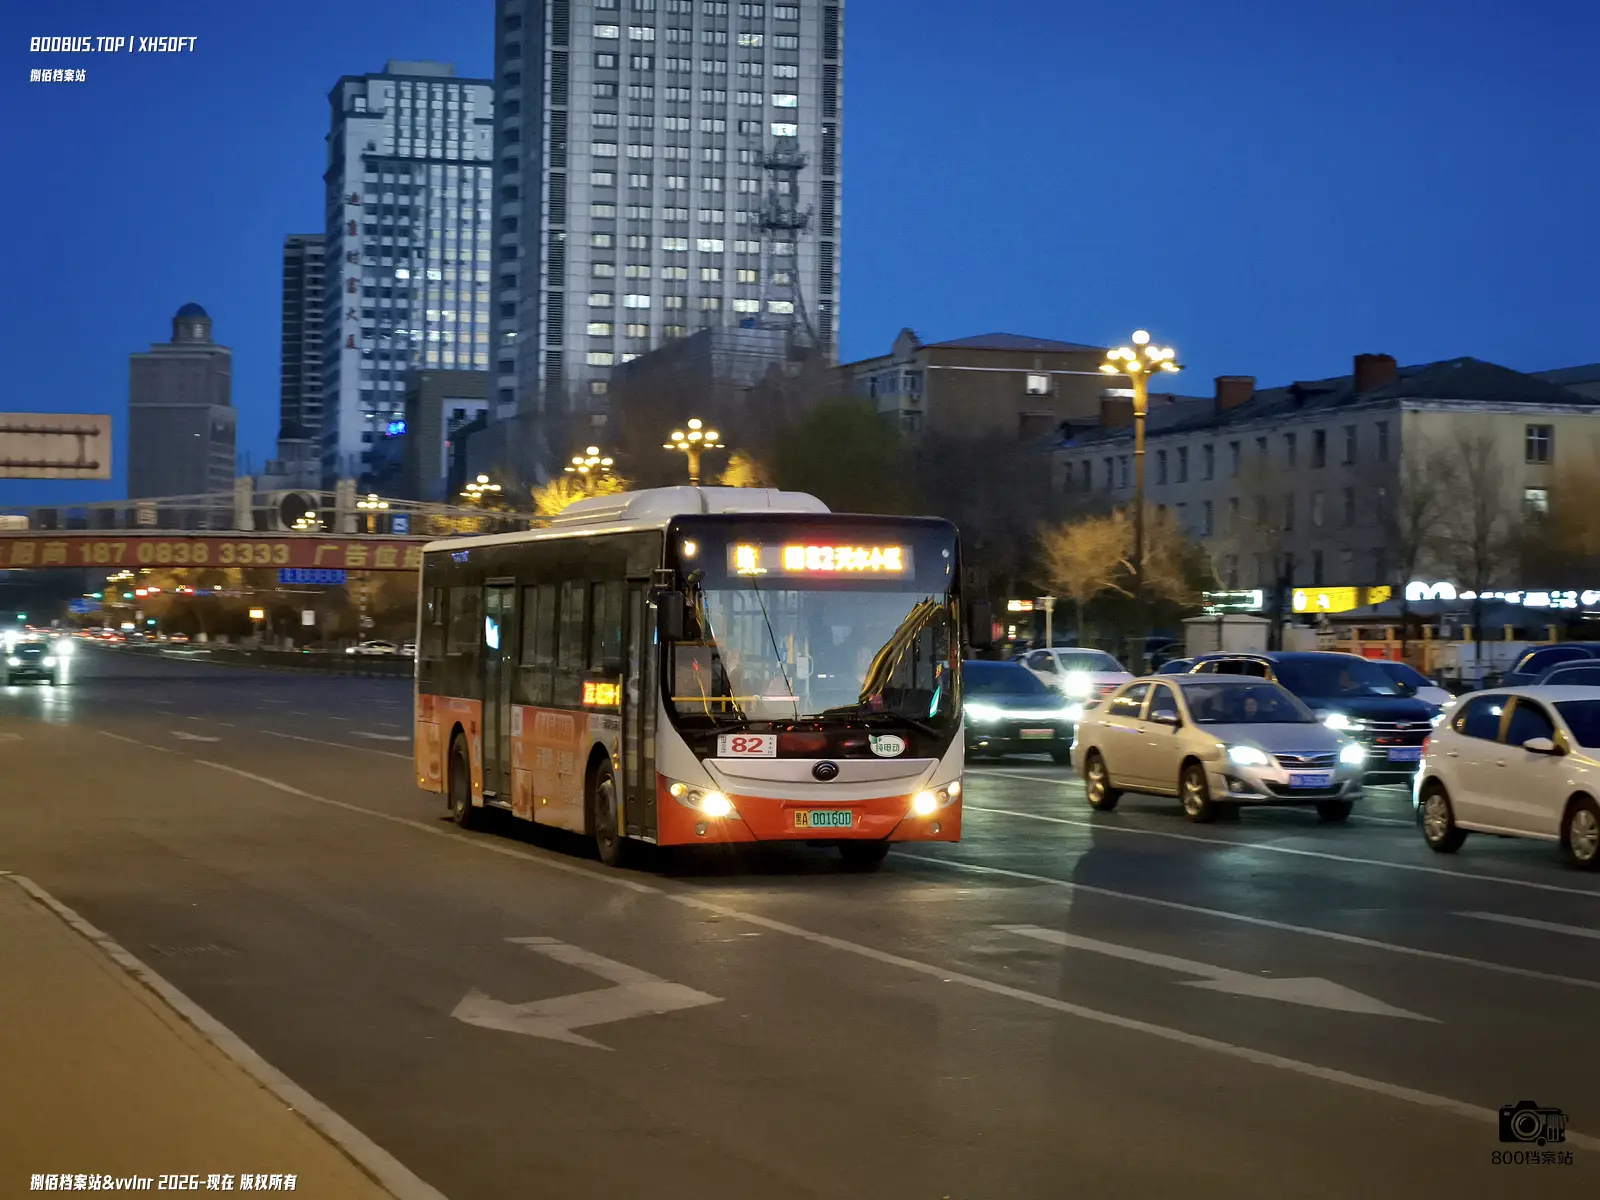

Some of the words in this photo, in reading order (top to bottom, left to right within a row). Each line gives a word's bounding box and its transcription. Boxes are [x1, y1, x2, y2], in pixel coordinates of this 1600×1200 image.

[80, 542, 127, 563] 187
[137, 542, 210, 564] 0838
[219, 543, 290, 564] 3333
[731, 737, 763, 753] 82
